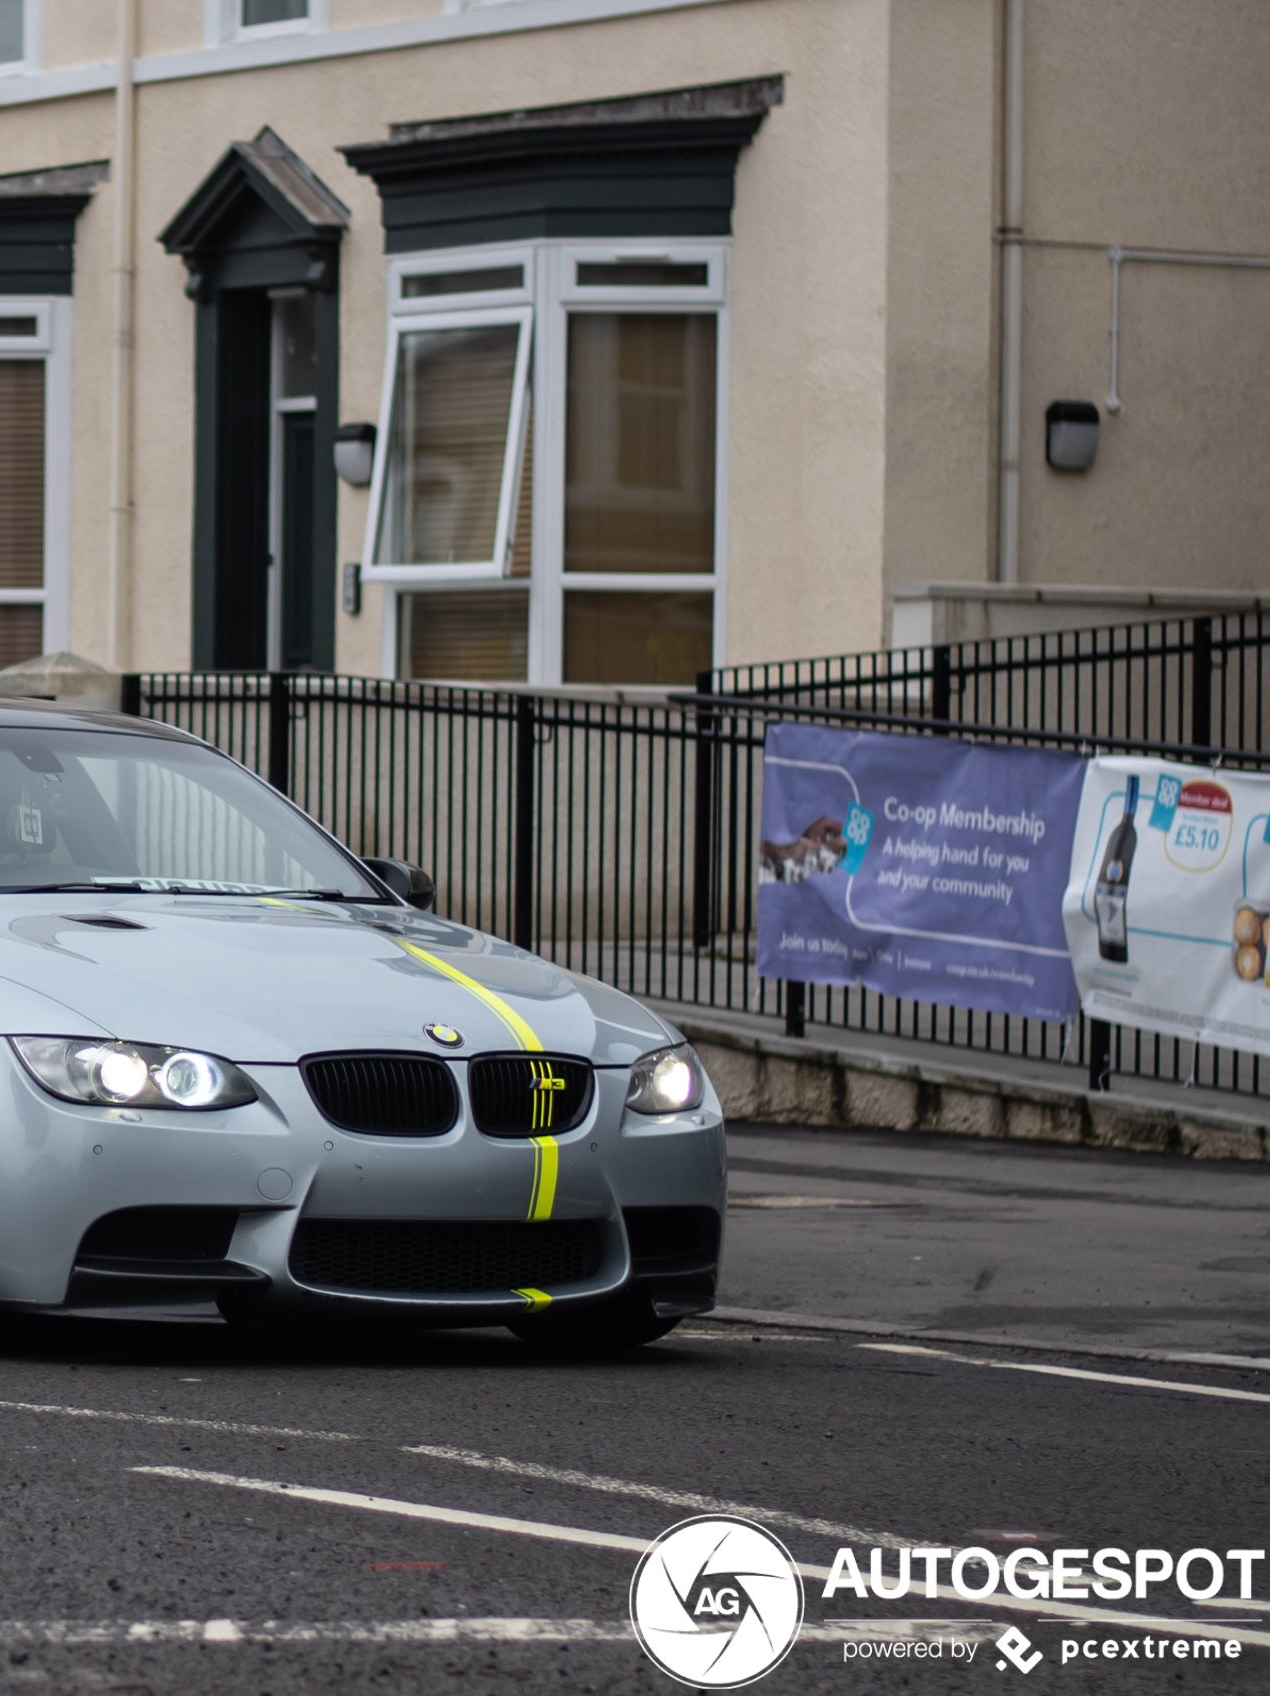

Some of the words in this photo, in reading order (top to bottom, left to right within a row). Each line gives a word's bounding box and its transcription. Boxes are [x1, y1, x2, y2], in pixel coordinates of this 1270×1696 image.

[883, 796, 936, 832] Co-op
[939, 801, 1045, 845] Membership
[1175, 824, 1219, 851] £5.10
[882, 836, 893, 855] A
[894, 836, 939, 867] helping
[942, 841, 978, 866] hand
[982, 846, 1003, 869] for
[1005, 855, 1029, 876] you
[878, 867, 902, 888] and
[902, 871, 929, 893] your
[932, 877, 1013, 906] community
[779, 931, 804, 950] Join
[807, 937, 820, 953] us
